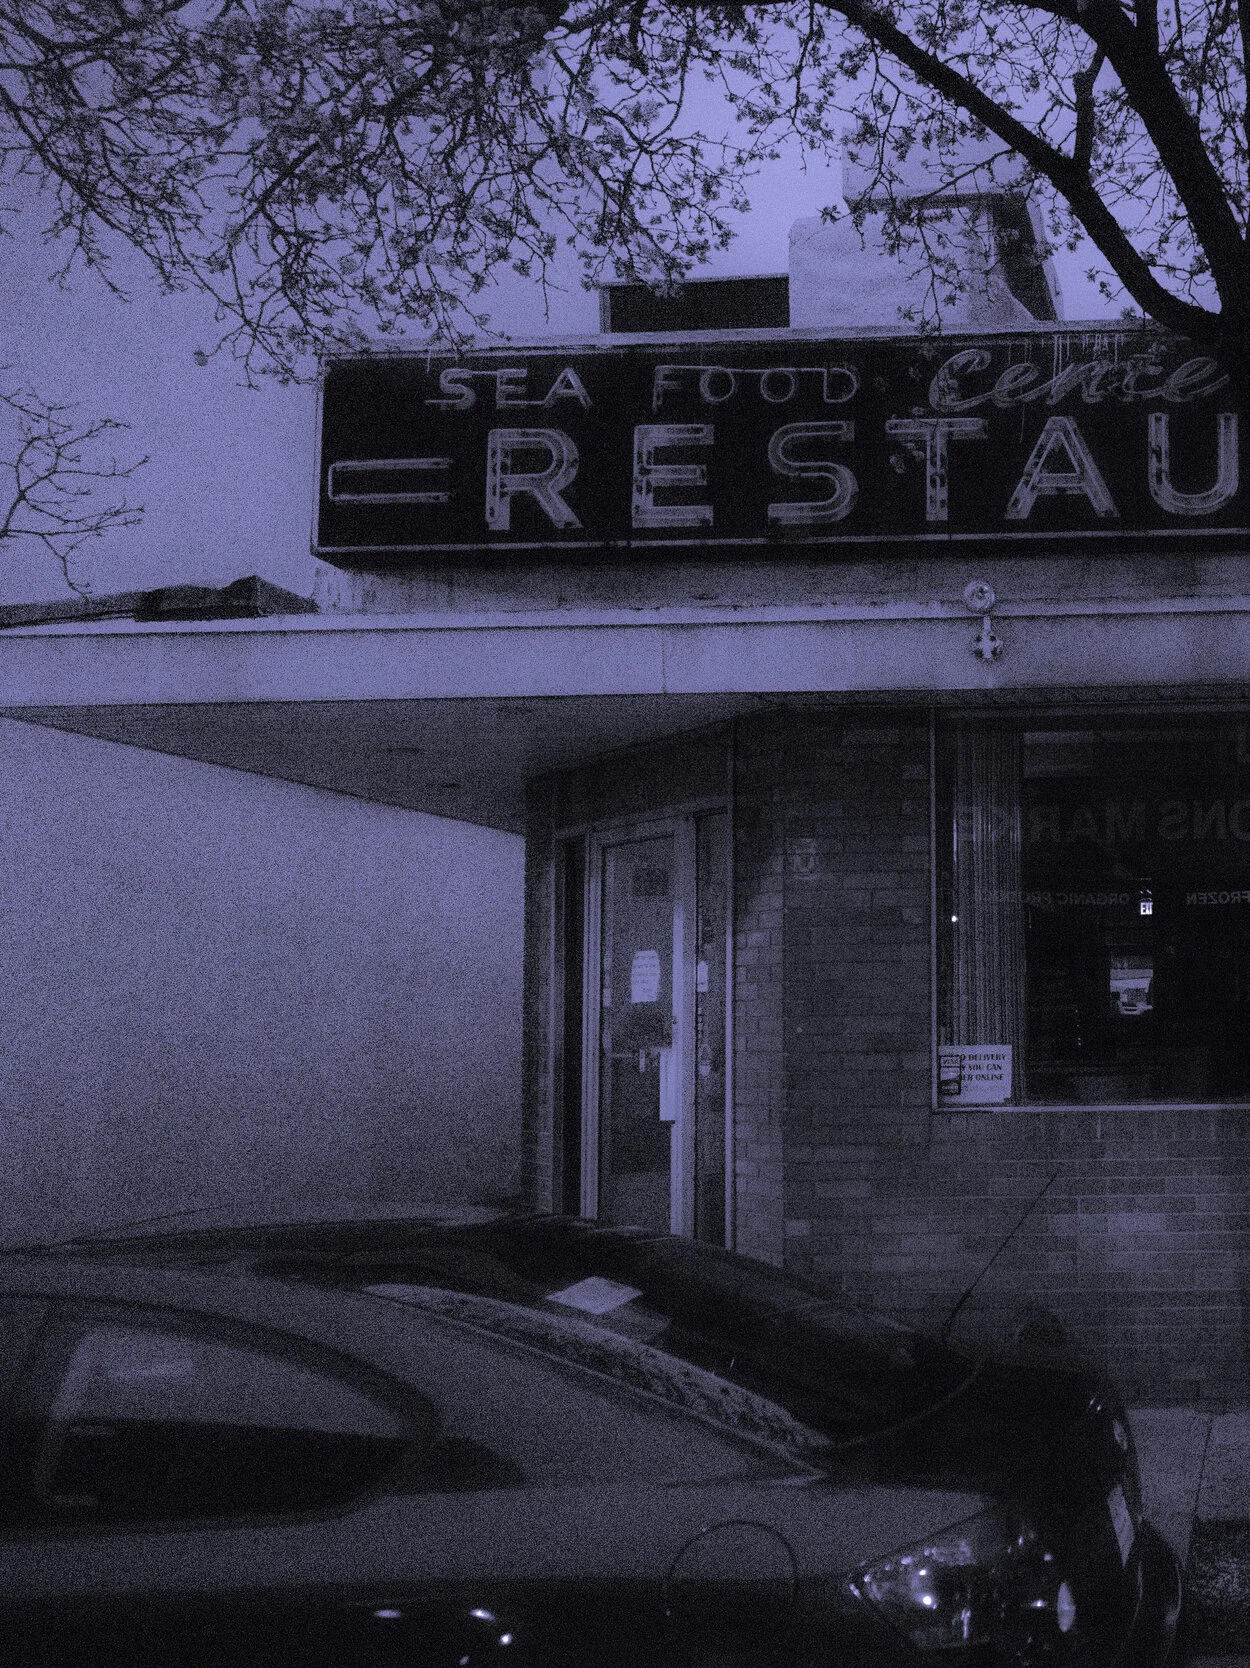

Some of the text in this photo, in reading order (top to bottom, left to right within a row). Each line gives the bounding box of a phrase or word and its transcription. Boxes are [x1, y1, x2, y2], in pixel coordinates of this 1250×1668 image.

[437, 363, 860, 411] SEA FOOD
[968, 1053, 1006, 1061] DELIVERY
[986, 1063, 1003, 1071] CAN
[975, 1073, 1004, 1081] ONLINE
